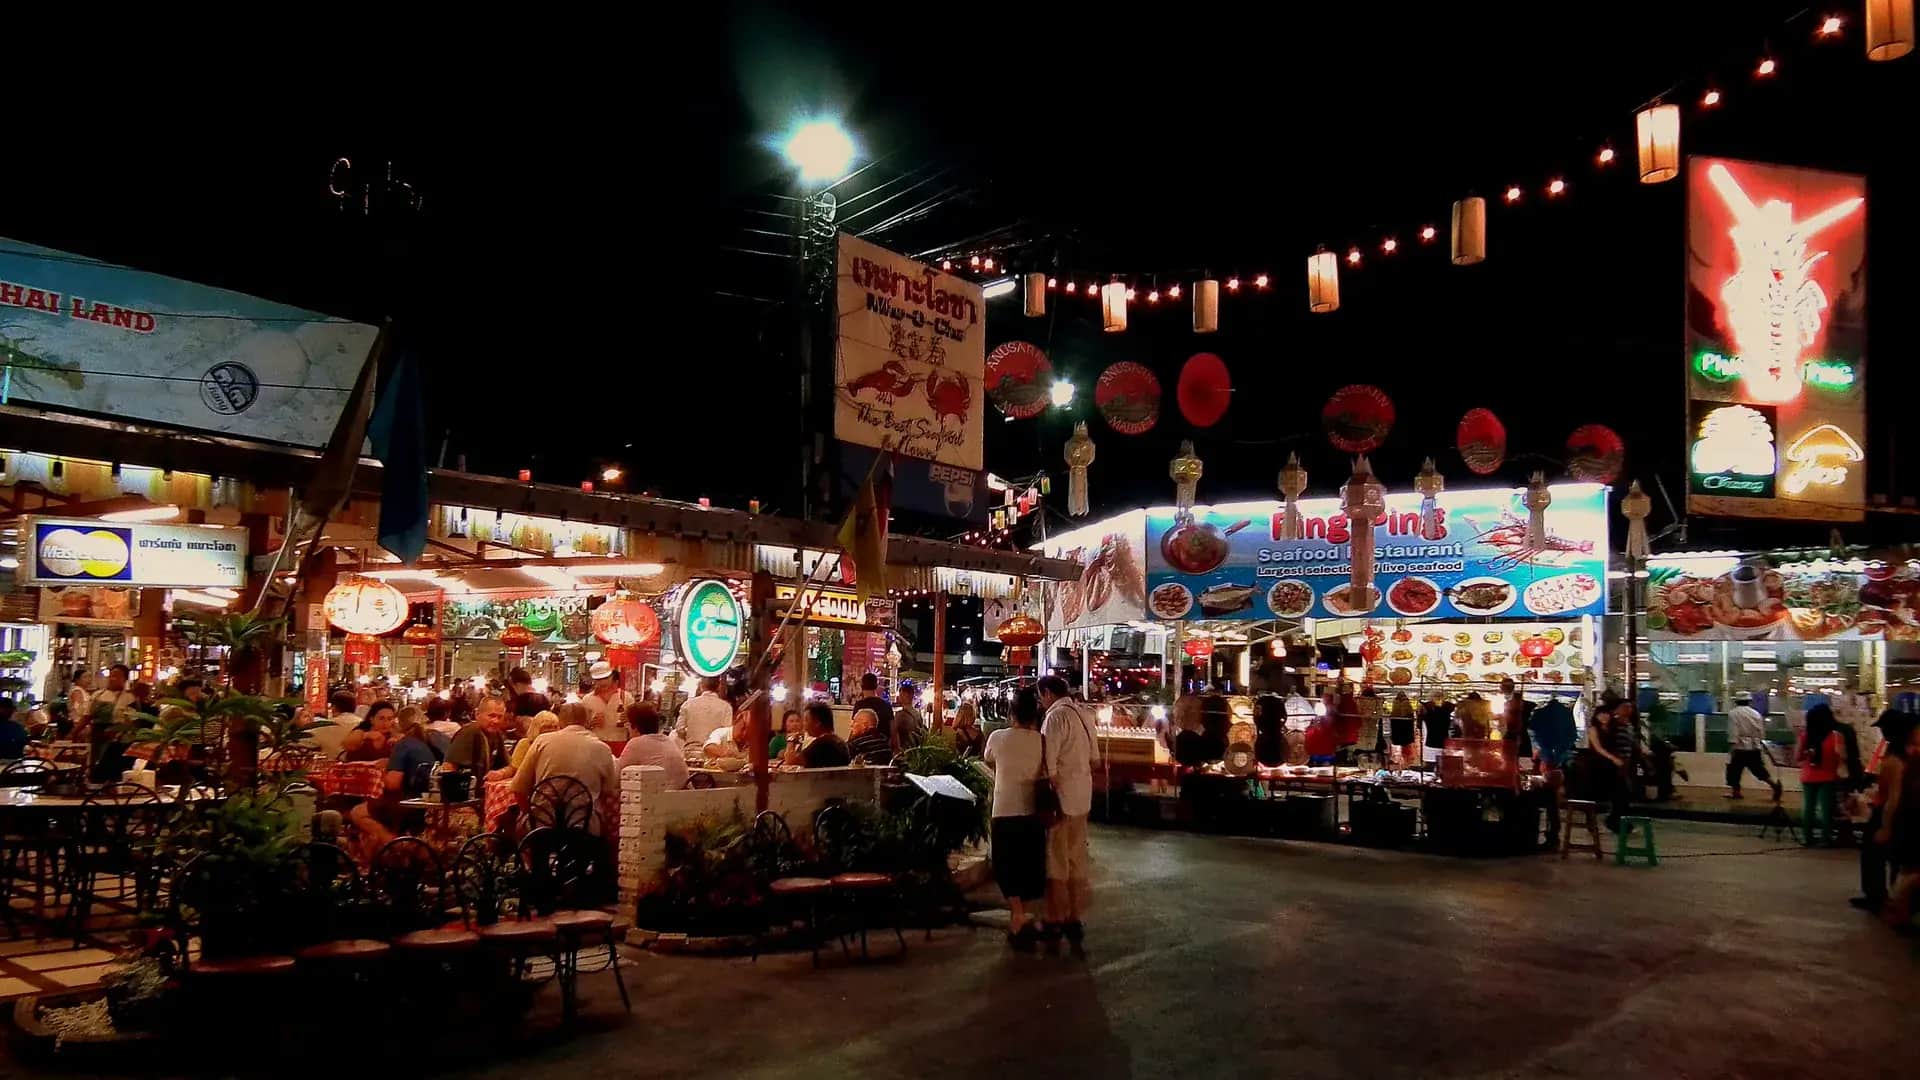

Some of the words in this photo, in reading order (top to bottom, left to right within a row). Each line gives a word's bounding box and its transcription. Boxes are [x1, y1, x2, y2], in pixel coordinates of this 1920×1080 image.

[71, 298, 155, 331] LAND
[931, 464, 976, 488] PEPSI
[1258, 544, 1339, 562] Seafood
[1346, 542, 1463, 559] staurant
[1258, 565, 1302, 577] Largest
[1383, 561, 1405, 573] live
[1409, 561, 1462, 572] seafood
[865, 597, 895, 609] PEPSI
